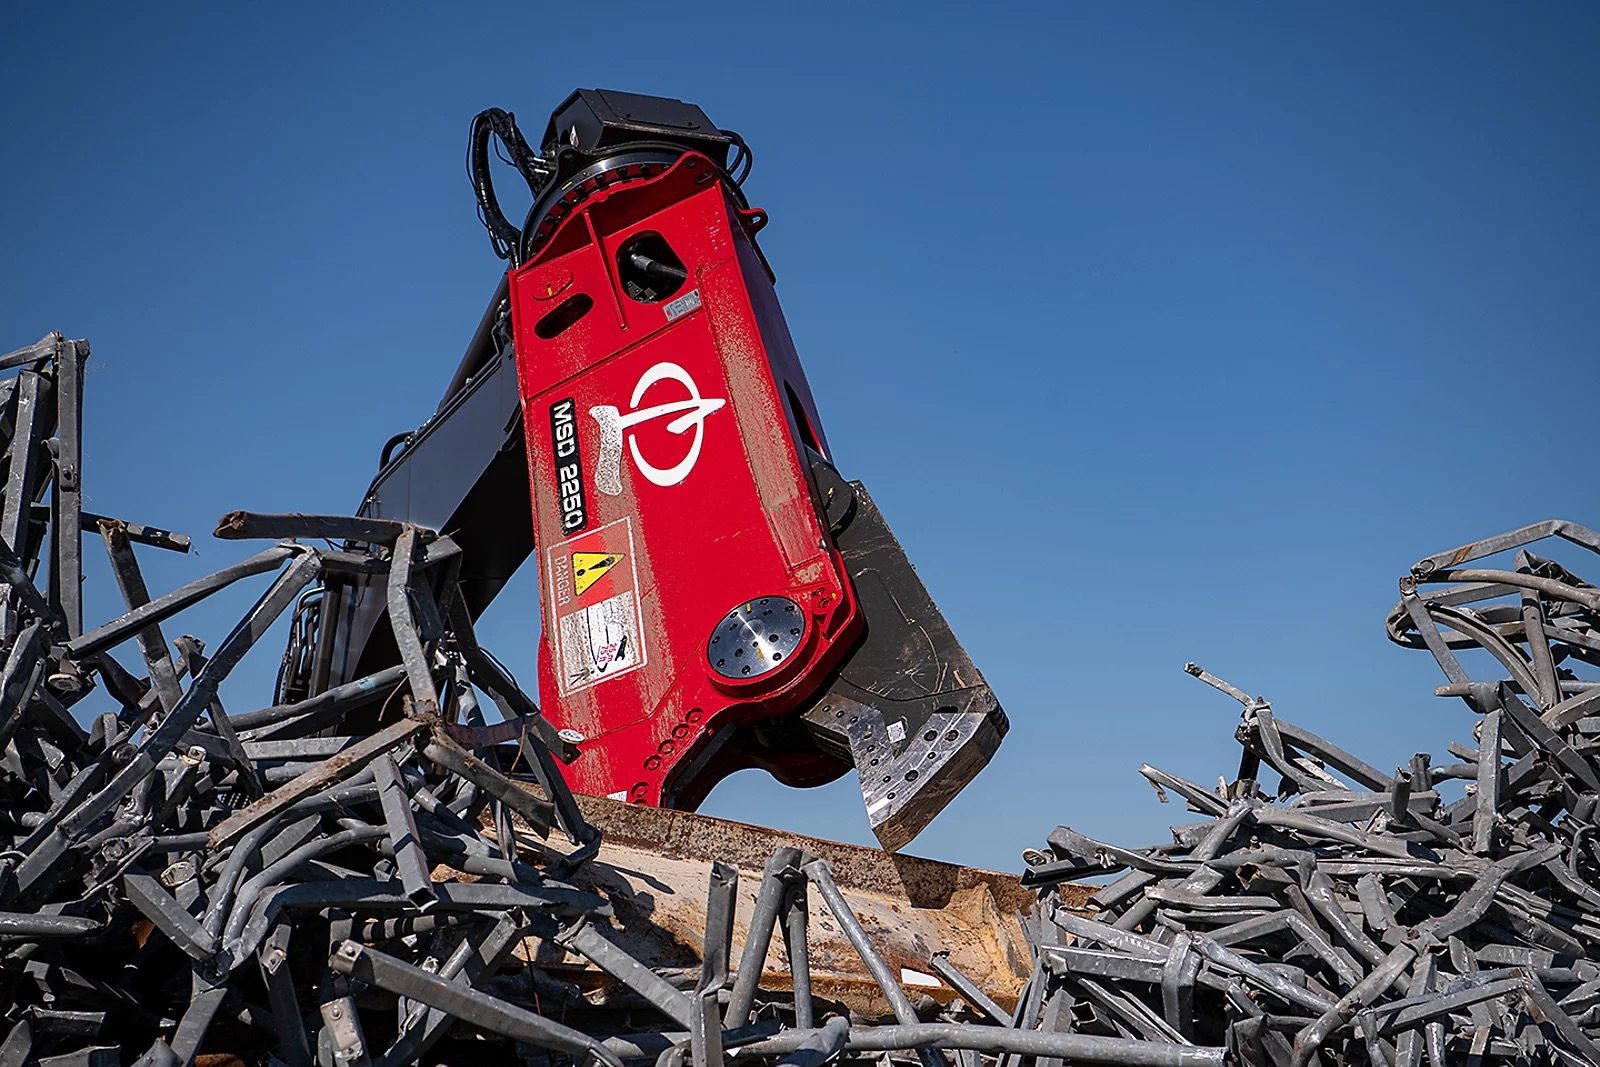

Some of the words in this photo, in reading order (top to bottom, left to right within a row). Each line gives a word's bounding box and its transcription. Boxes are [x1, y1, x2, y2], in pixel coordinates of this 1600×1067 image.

[553, 402, 576, 458] MSD
[560, 463, 583, 529] 2250
[554, 556, 571, 607] DANGER
